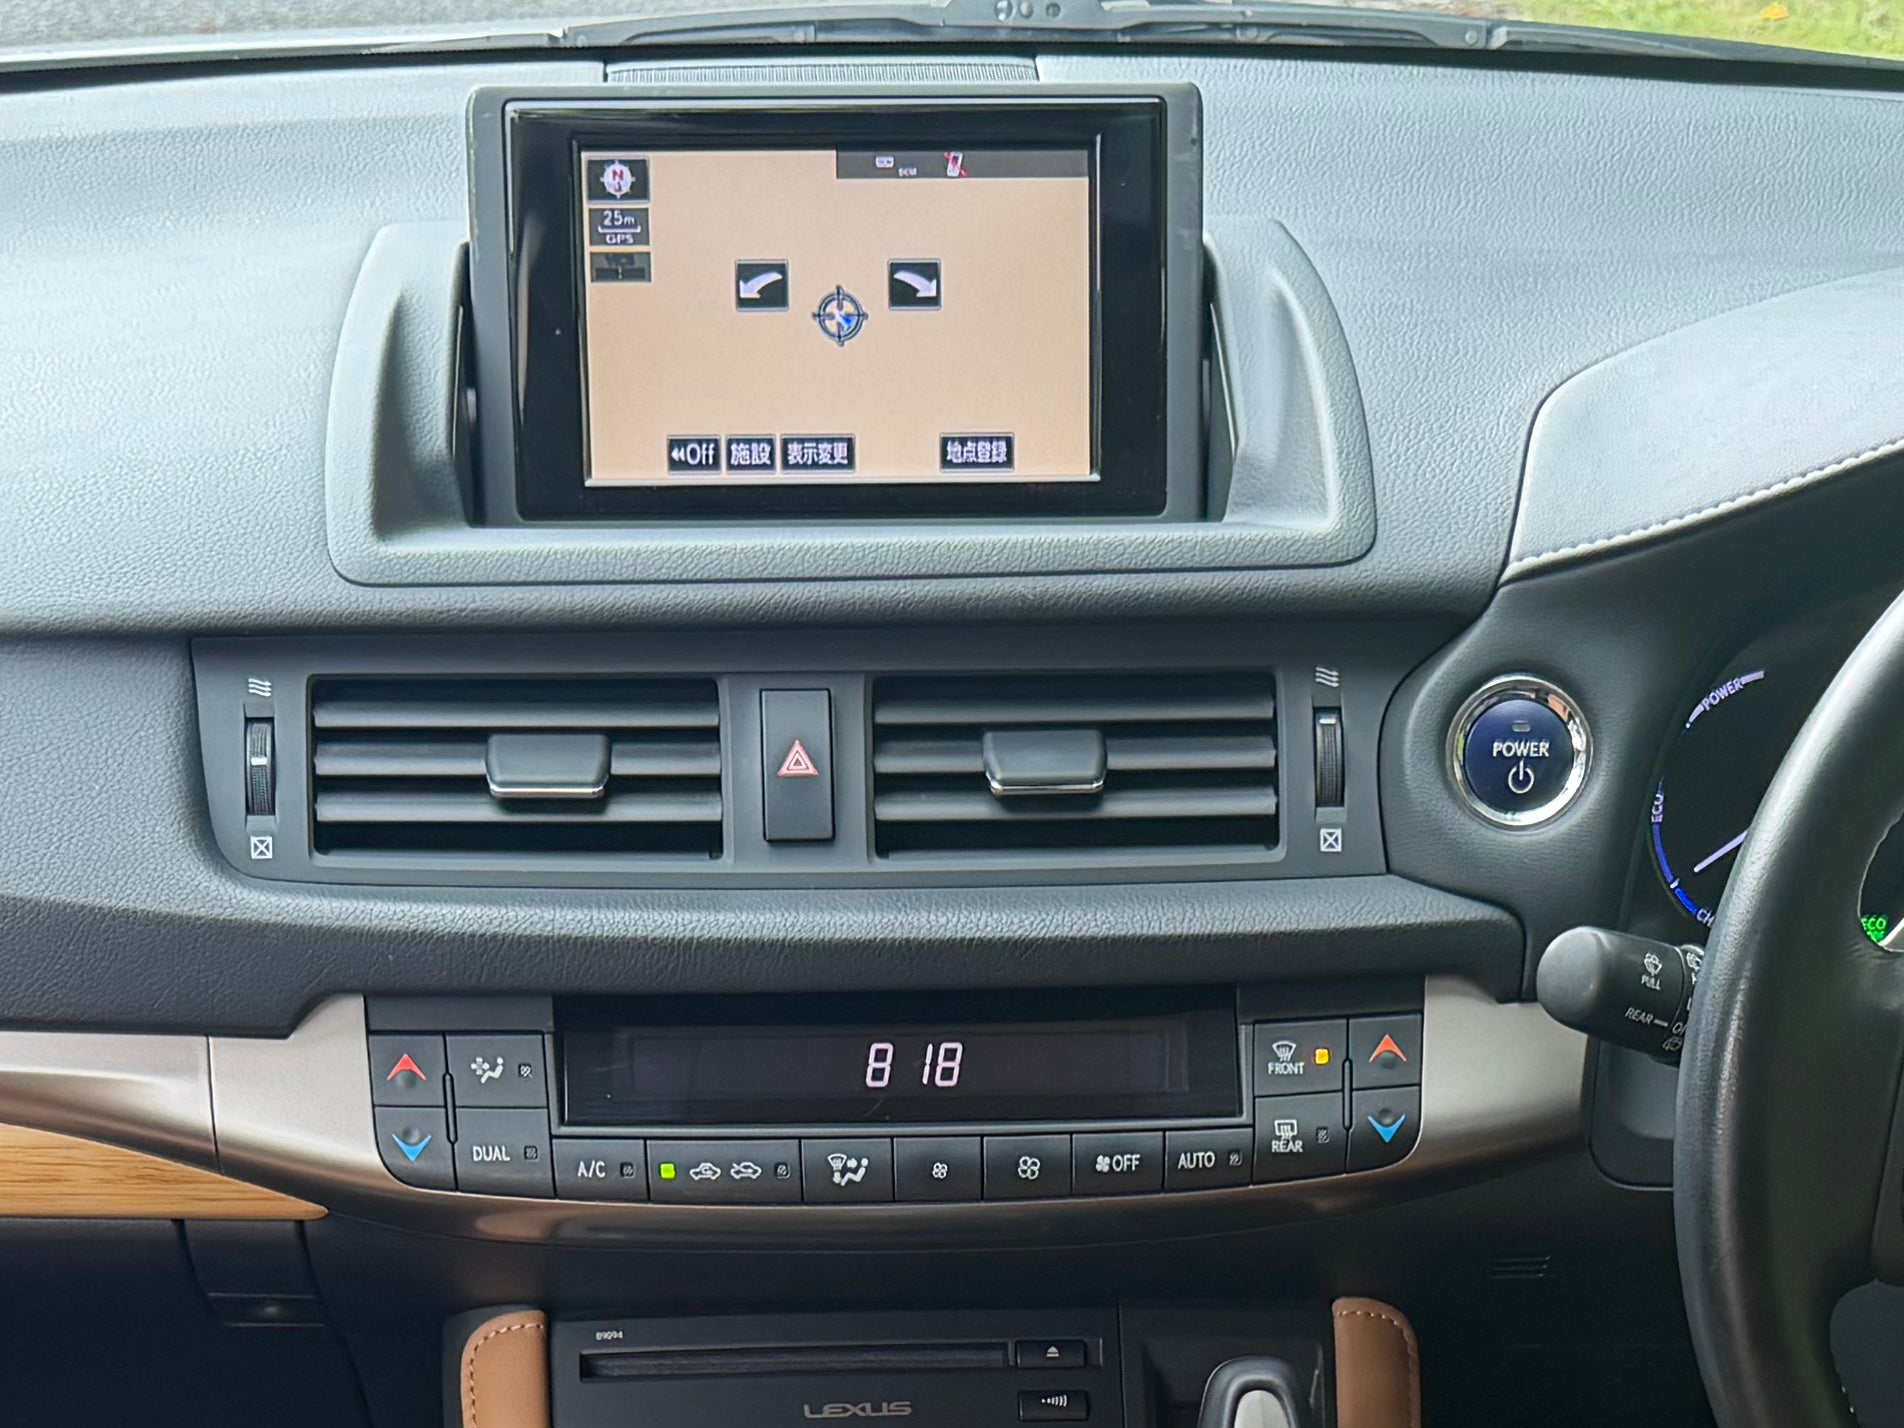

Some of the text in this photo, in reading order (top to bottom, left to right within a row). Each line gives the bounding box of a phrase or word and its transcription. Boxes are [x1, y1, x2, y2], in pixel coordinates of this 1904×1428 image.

[603, 210, 635, 226] 25m
[606, 233, 634, 244] GPS
[686, 443, 715, 466] Off
[730, 443, 771, 466] 施設
[787, 443, 848, 466] 表示変更
[946, 441, 1008, 464] 地点登録
[1700, 677, 1744, 711] POWER
[1492, 741, 1550, 757] POWER
[1641, 974, 1661, 990] PULL
[1624, 1006, 1653, 1025] REAR
[865, 1042, 963, 1088] 8 18
[1267, 1061, 1305, 1075] FRONT
[472, 1145, 511, 1162] DUAL
[1271, 1139, 1303, 1153] REAR
[577, 1160, 606, 1178] A/C
[1112, 1153, 1141, 1172] OFF
[1177, 1151, 1216, 1170] AUTO
[804, 1401, 912, 1418] LEXUS
